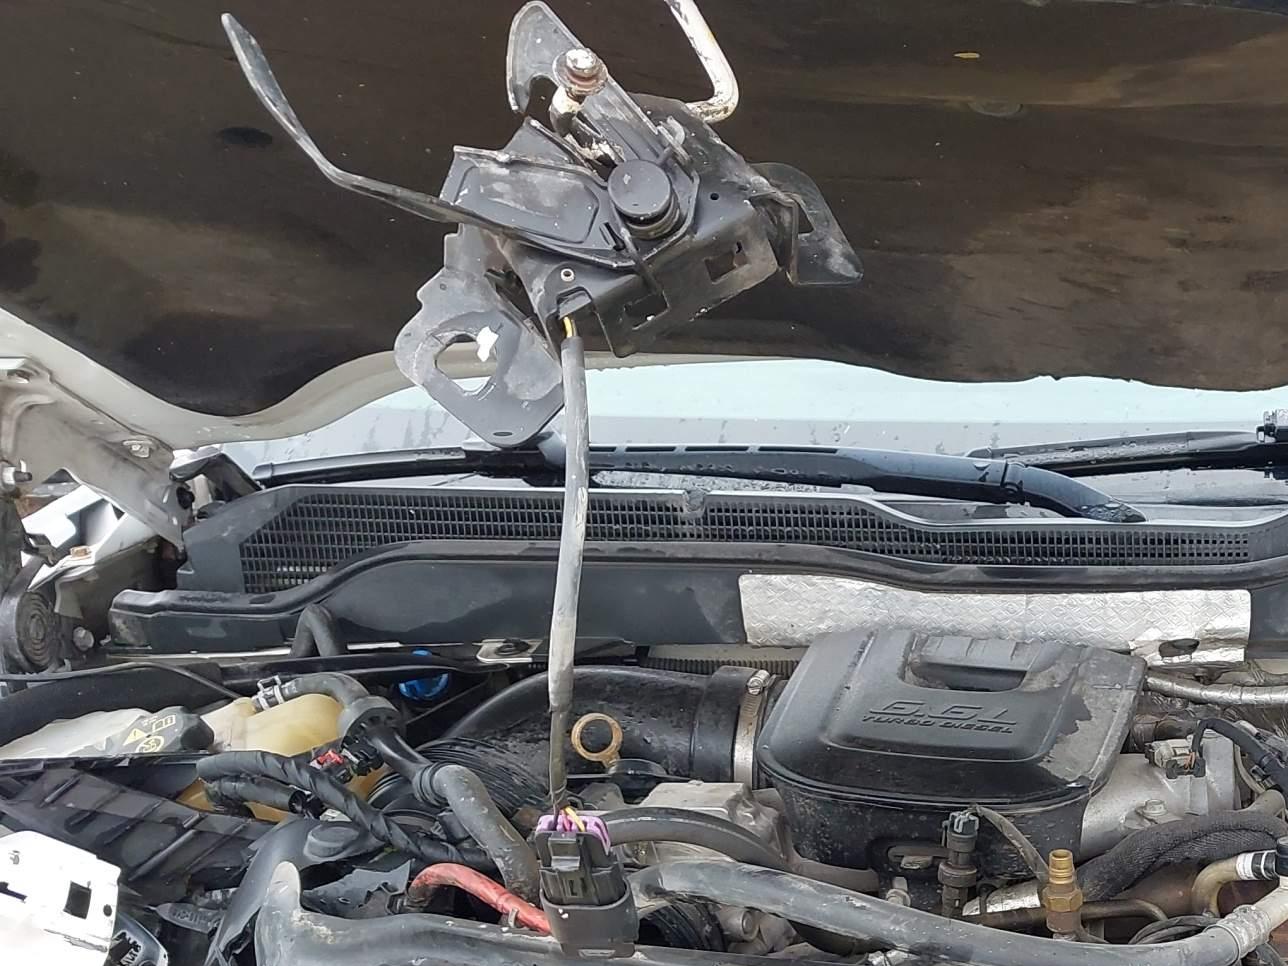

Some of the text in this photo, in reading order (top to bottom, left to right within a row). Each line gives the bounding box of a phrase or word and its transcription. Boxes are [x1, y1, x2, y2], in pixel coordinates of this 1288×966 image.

[869, 699, 1017, 726] 6.6L
[862, 715, 1014, 735] TURBO DIESEL
